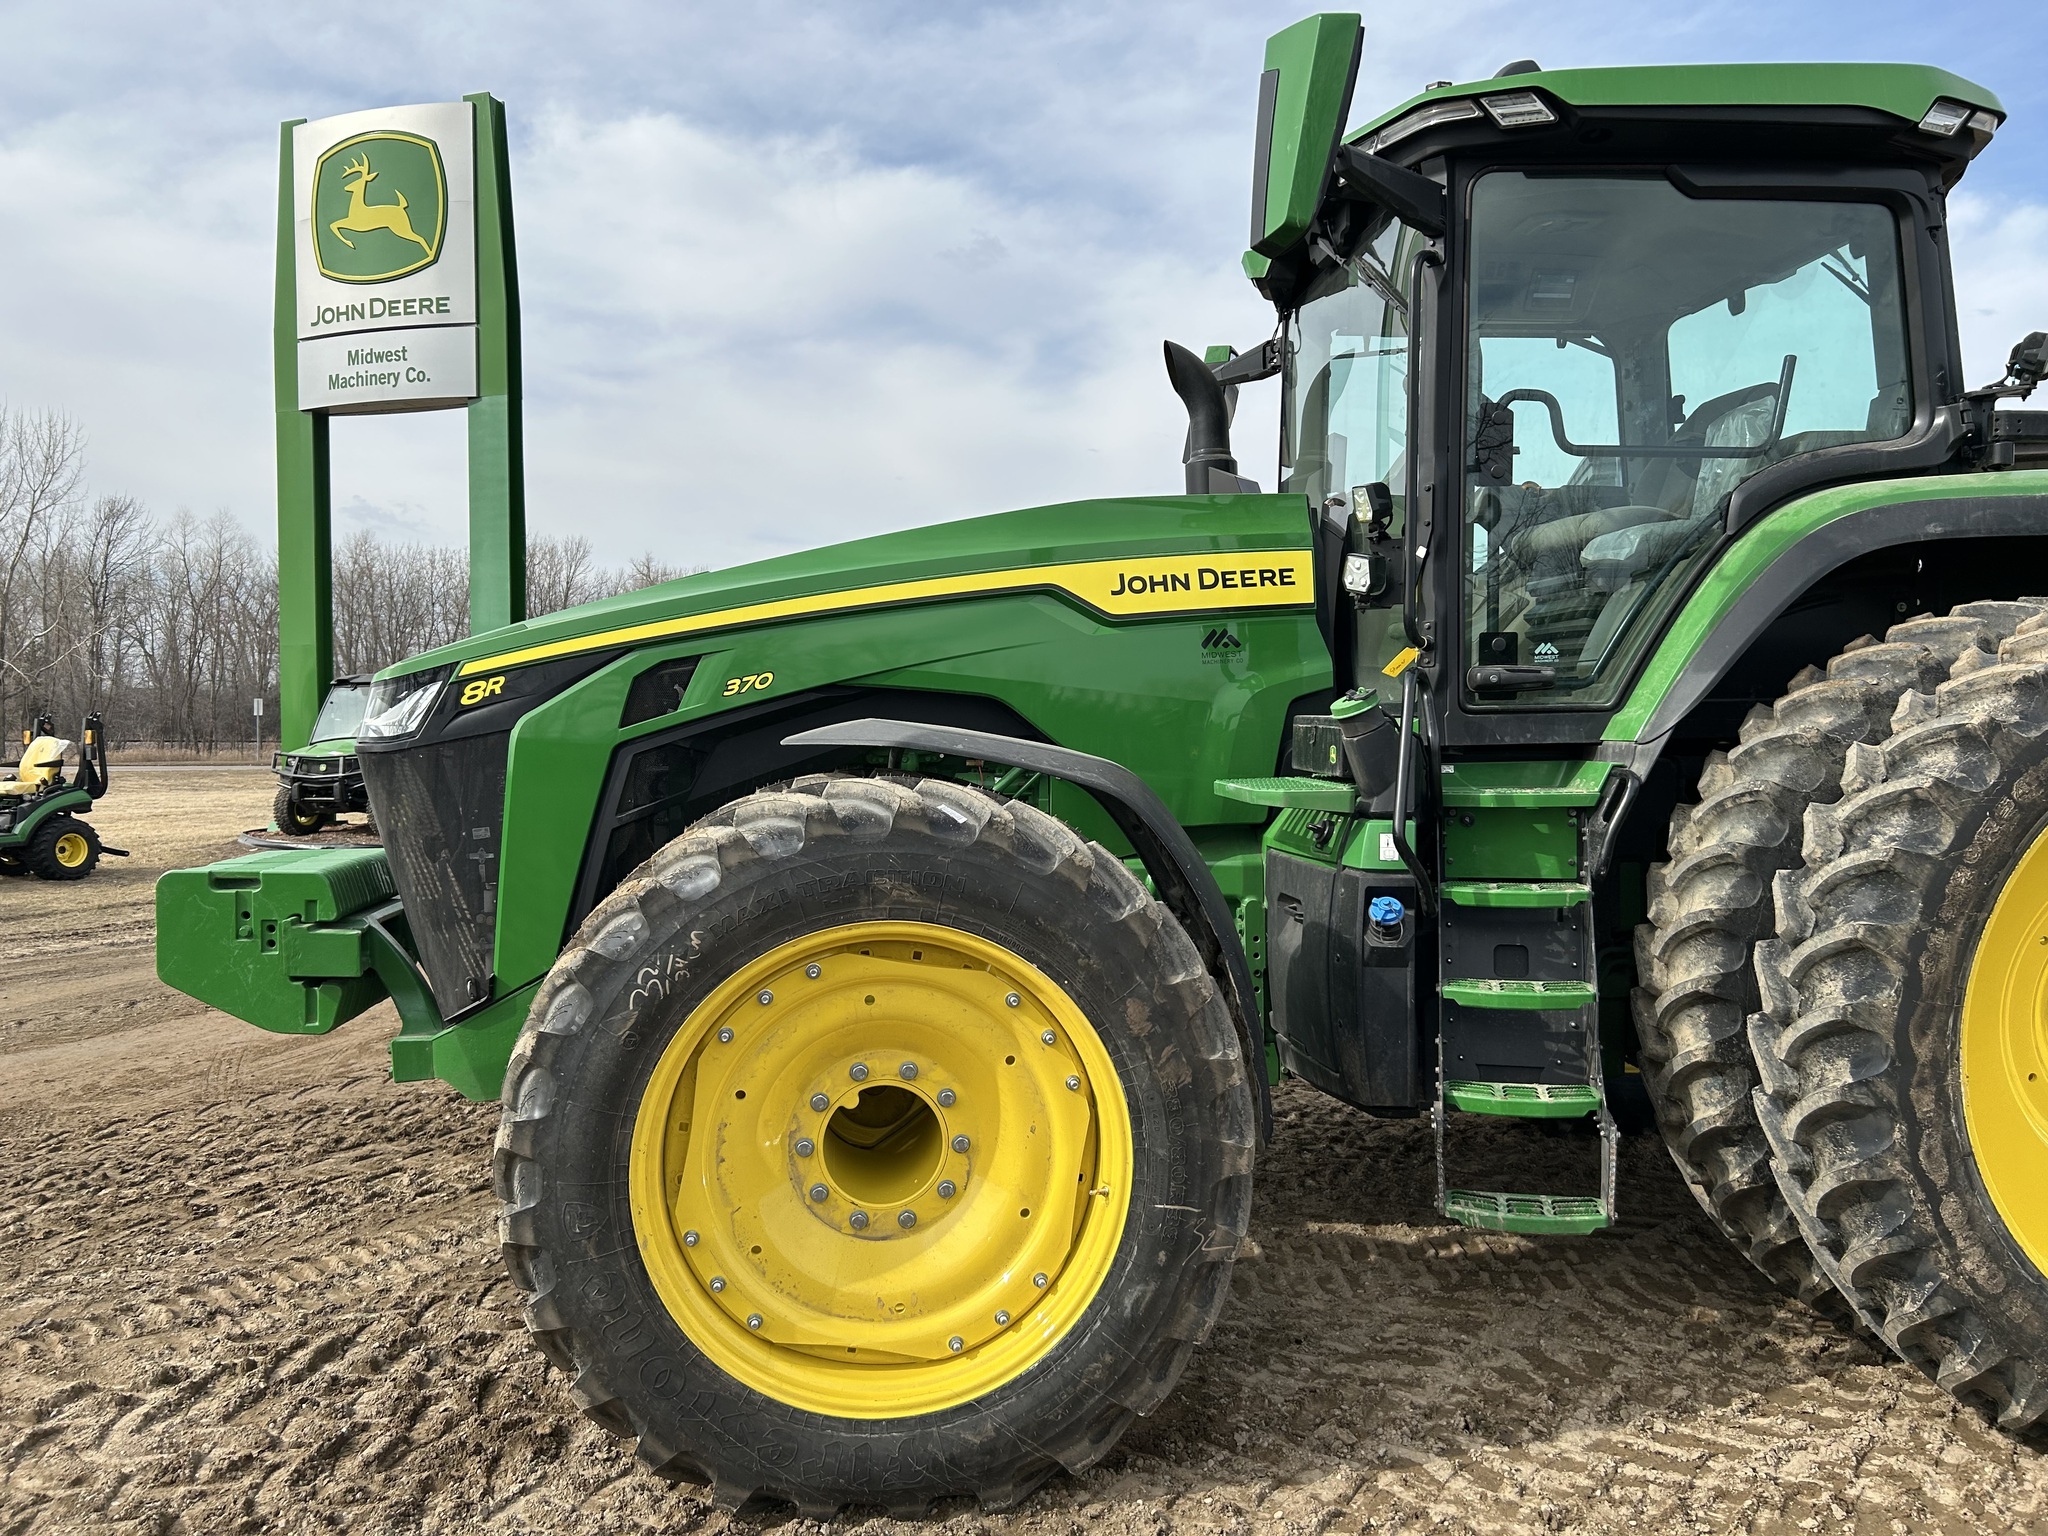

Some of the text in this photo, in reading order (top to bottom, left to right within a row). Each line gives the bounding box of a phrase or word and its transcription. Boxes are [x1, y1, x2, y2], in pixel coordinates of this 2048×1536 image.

[310, 296, 450, 327] JOHN DEERE
[347, 346, 407, 366] Midwest
[328, 366, 431, 391] Machinery Co.
[1110, 568, 1296, 596] JOHN DEERE
[460, 675, 506, 706] 8R
[722, 671, 775, 697] 370
[707, 886, 791, 941] MAXI
